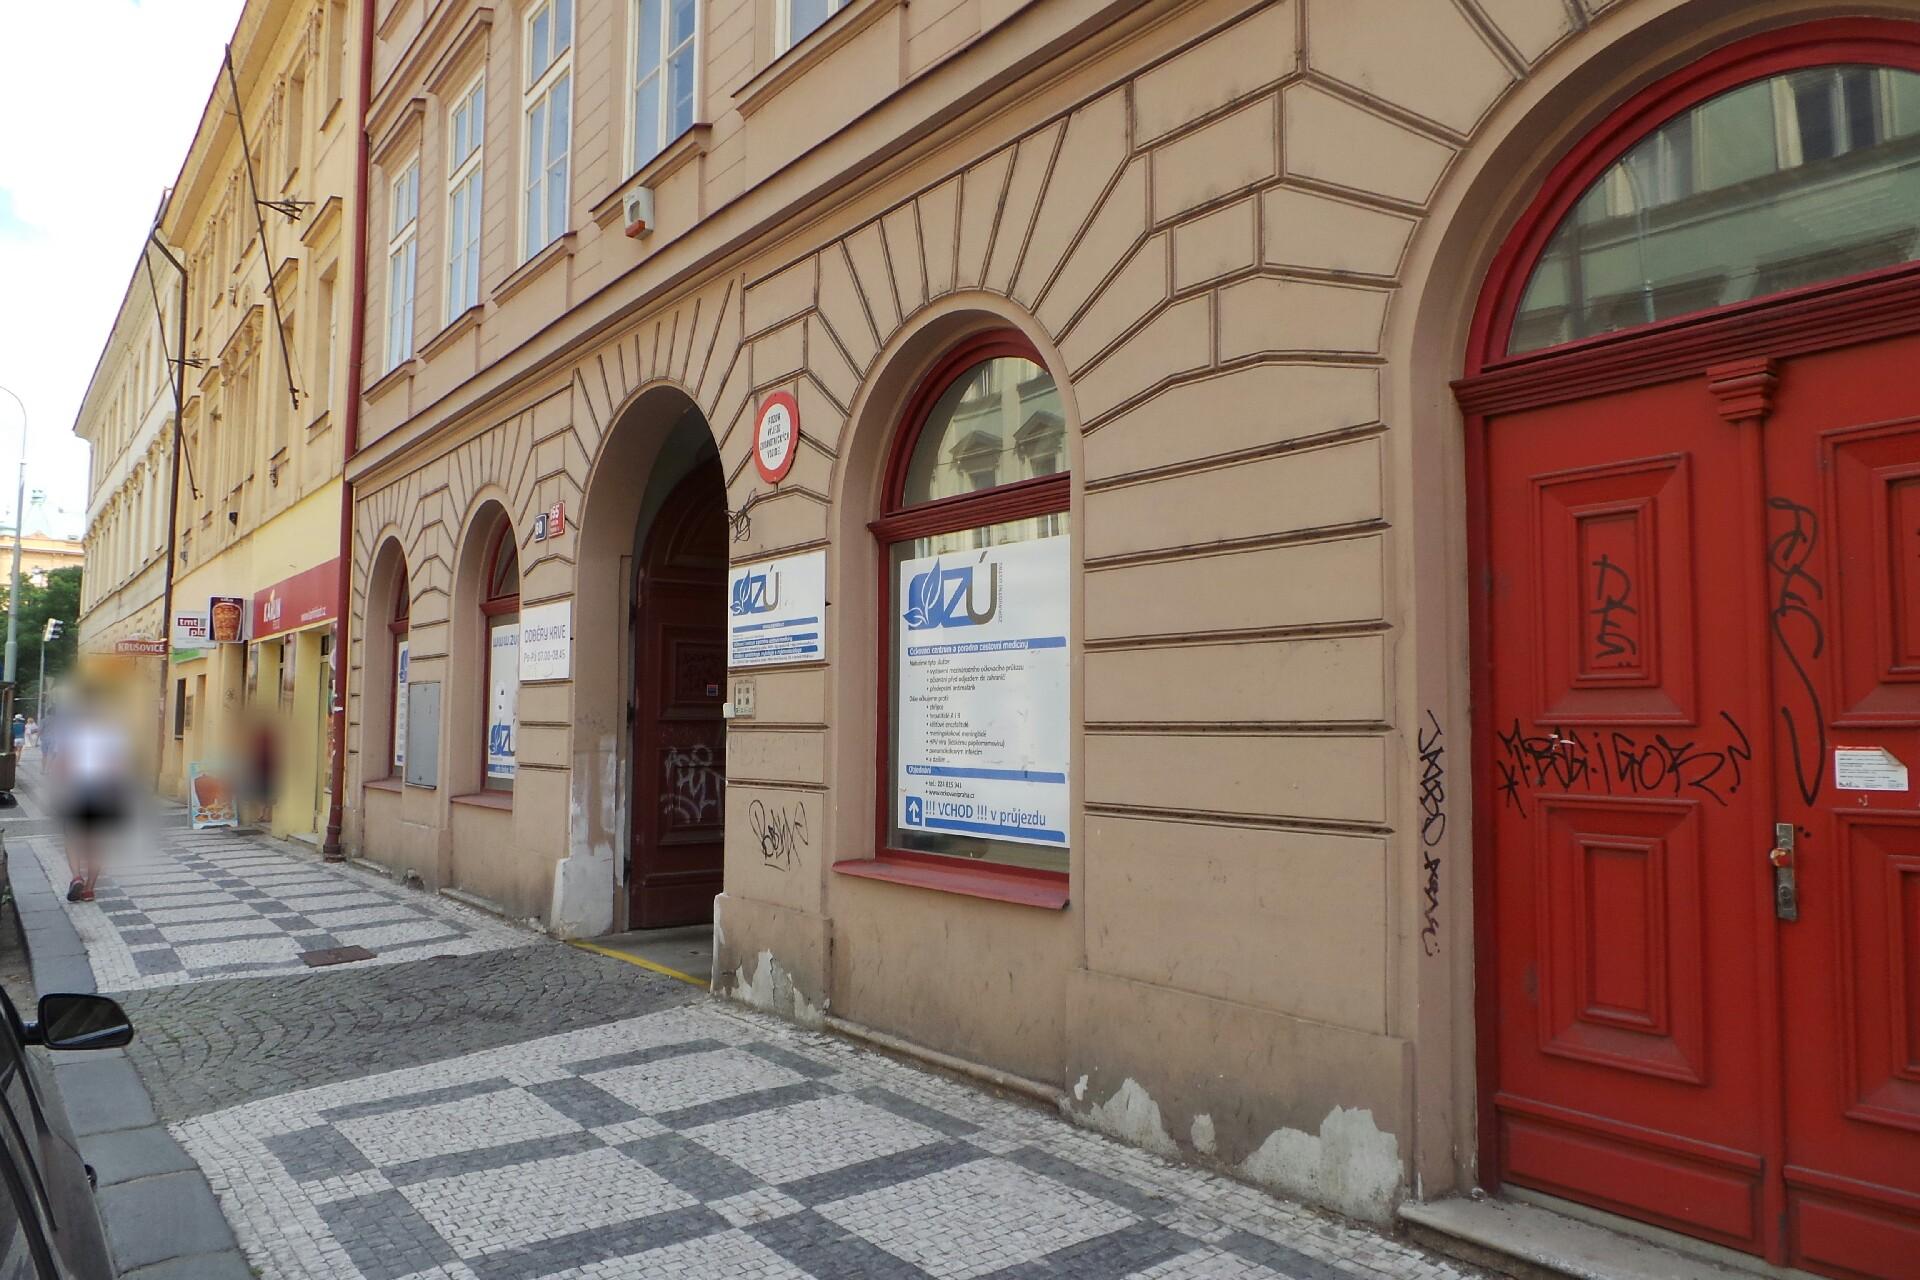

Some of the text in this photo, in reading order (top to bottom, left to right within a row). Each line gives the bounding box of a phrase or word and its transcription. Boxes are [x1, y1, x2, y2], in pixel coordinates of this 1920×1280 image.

[925, 800, 1046, 828] !!! VCHOD !!! v průjezdu
